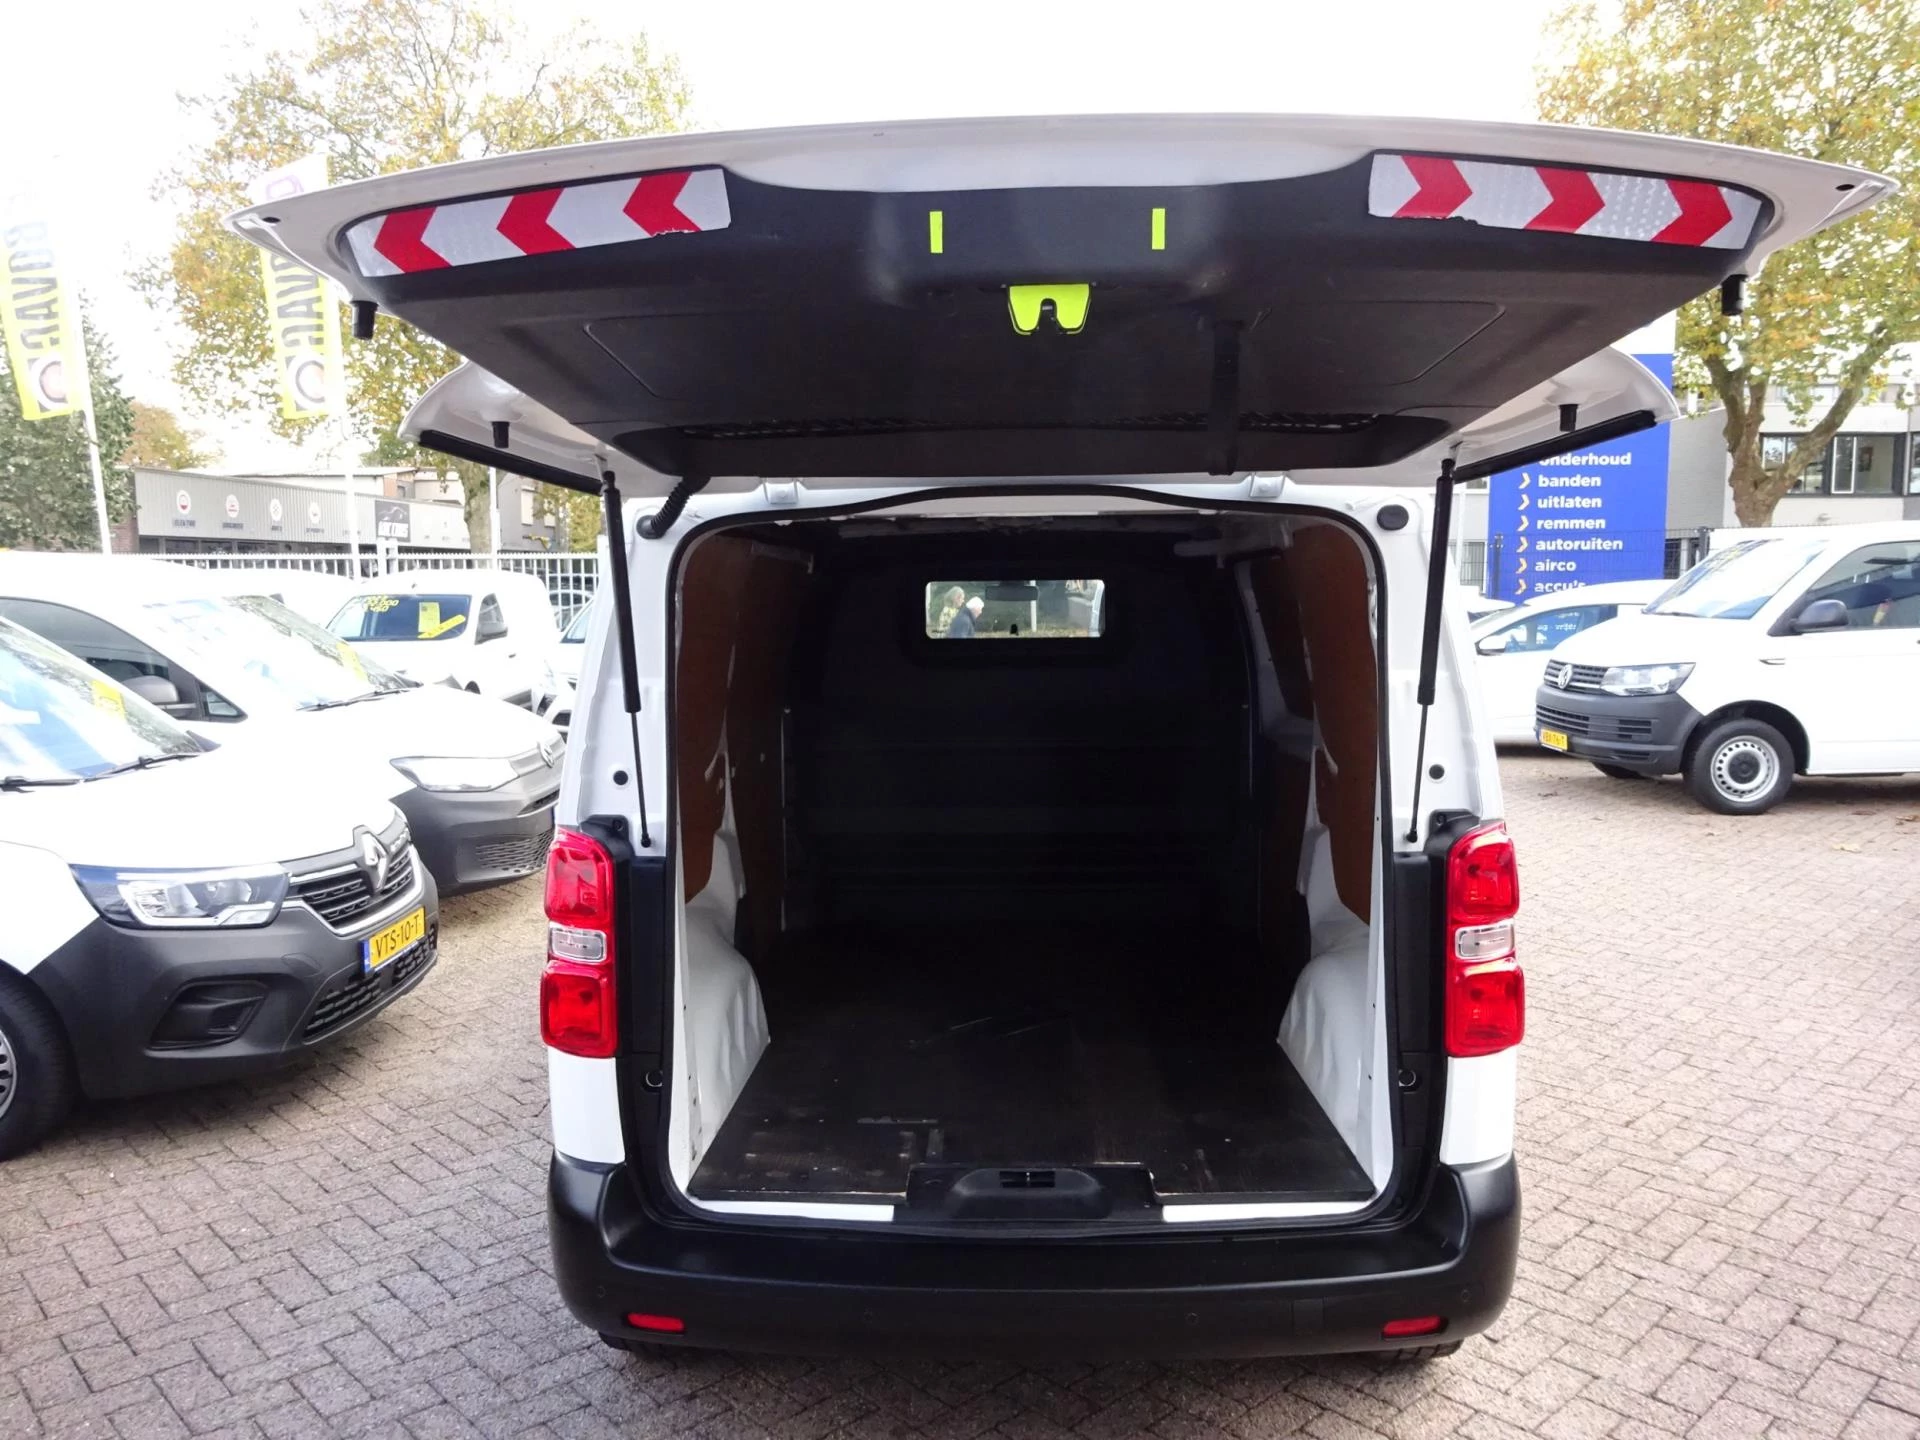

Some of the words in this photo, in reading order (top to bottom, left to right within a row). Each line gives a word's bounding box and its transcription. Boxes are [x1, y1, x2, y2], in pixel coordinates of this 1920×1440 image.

[1537, 474, 1602, 488] banden
[1537, 494, 1603, 509] uitlaten
[1536, 518, 1606, 530] remmen
[1535, 538, 1624, 551] autoruiten
[1534, 558, 1577, 572] airco
[375, 914, 420, 959] VTS-10-T
